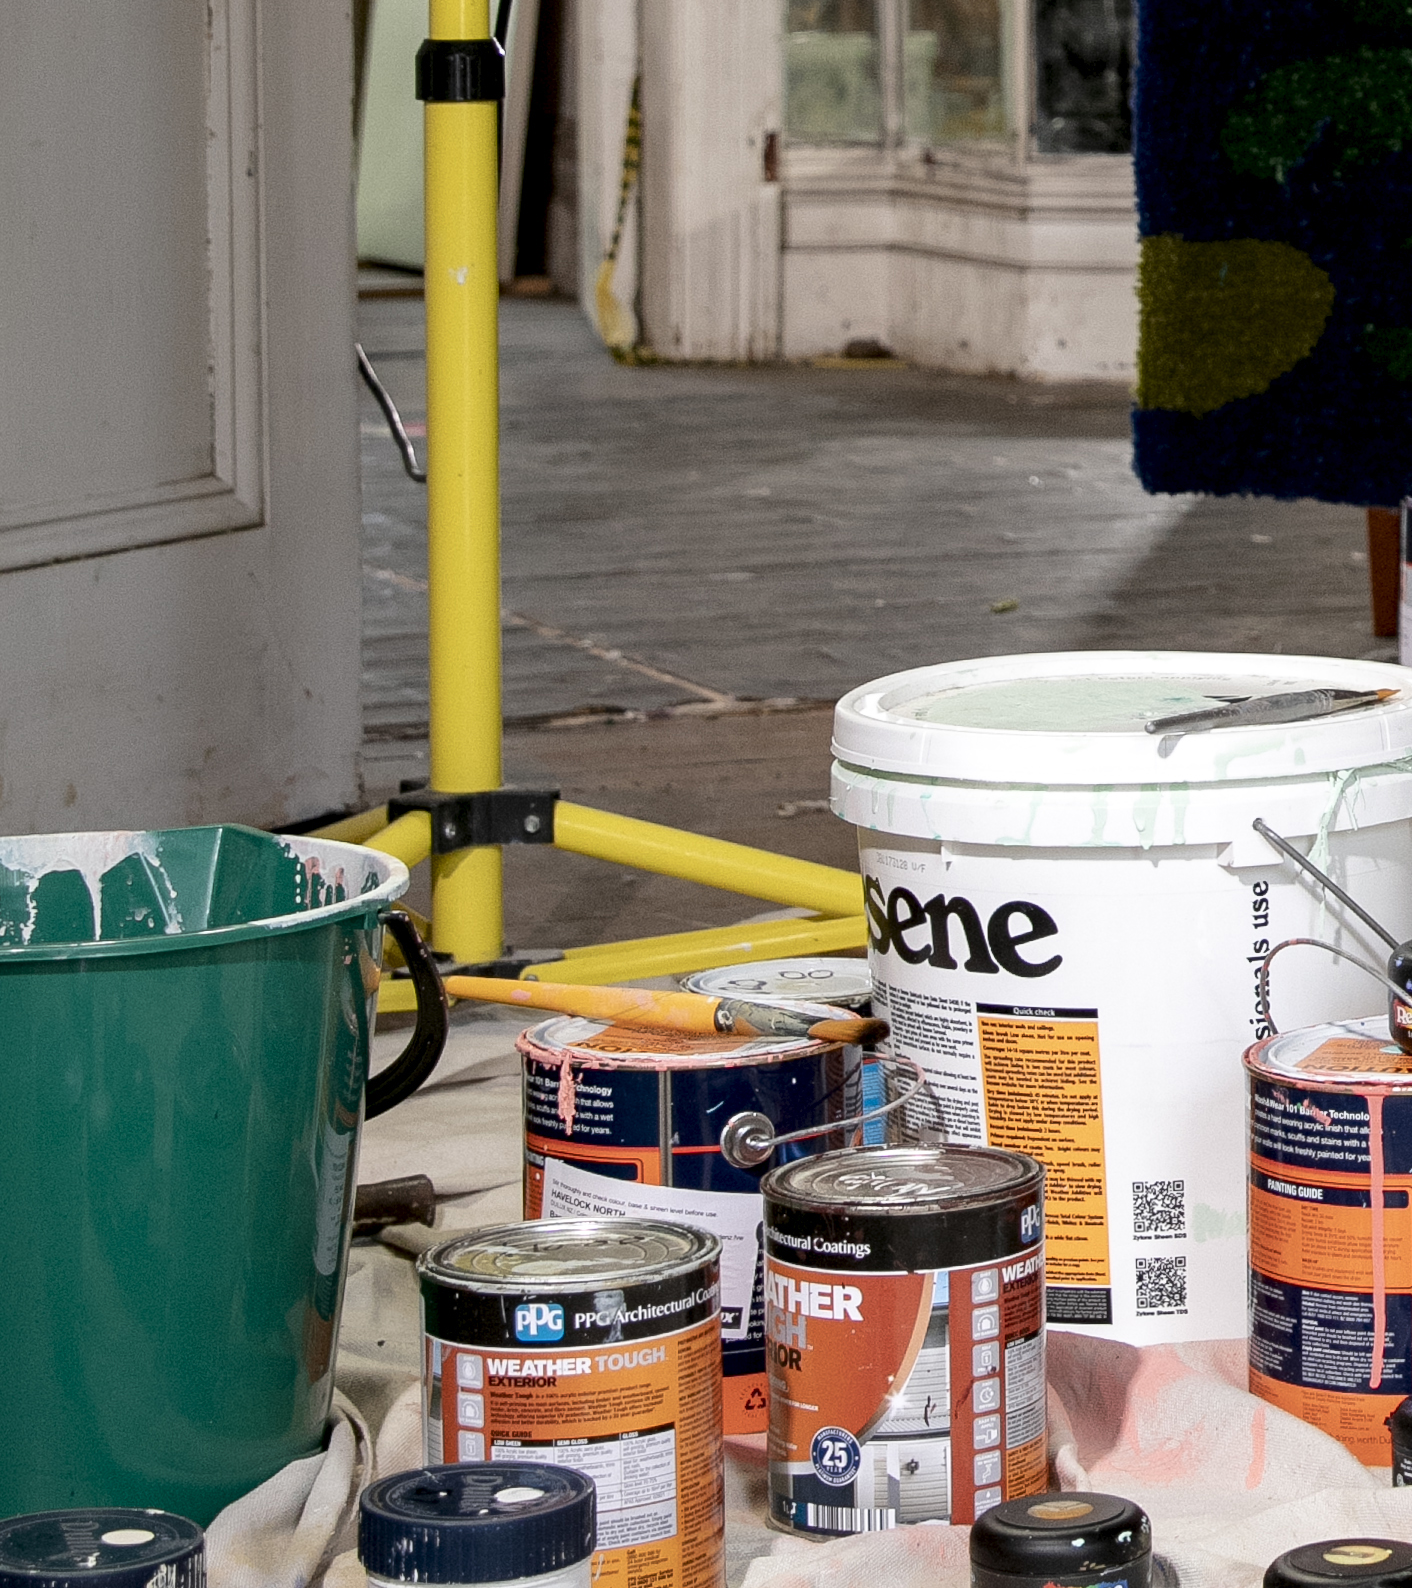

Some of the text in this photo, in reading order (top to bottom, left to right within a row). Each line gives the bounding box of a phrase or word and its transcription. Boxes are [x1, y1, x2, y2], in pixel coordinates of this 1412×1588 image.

[1251, 880, 1269, 929] use
[1013, 1006, 1056, 1017] Quick check
[1286, 1103, 1298, 1114] 101
[600, 1114, 614, 1122] wet
[591, 1126, 612, 1135] years.
[1344, 1124, 1358, 1134] that
[1306, 1134, 1320, 1144] and
[1321, 1135, 1343, 1147] stains
[1344, 1138, 1361, 1147] with
[1295, 1146, 1317, 1158] freshly
[1317, 1149, 1344, 1161] painted
[1345, 1152, 1356, 1161] for
[1267, 1178, 1324, 1200] PAINTING GUIDE
[551, 1189, 591, 1211] HAVELOCK
[593, 1204, 626, 1217] NORTH
[813, 1237, 871, 1260] Coatings
[575, 1311, 612, 1329] PPG
[614, 1295, 695, 1325] Architectural
[517, 1303, 563, 1336] PPG
[487, 1345, 666, 1376] WEATHER TOUGH
[488, 1376, 557, 1388] EXTERIOR
[622, 1431, 639, 1439] GLOSS
[1356, 1434, 1379, 1445] worth
[821, 1440, 848, 1468] 25
